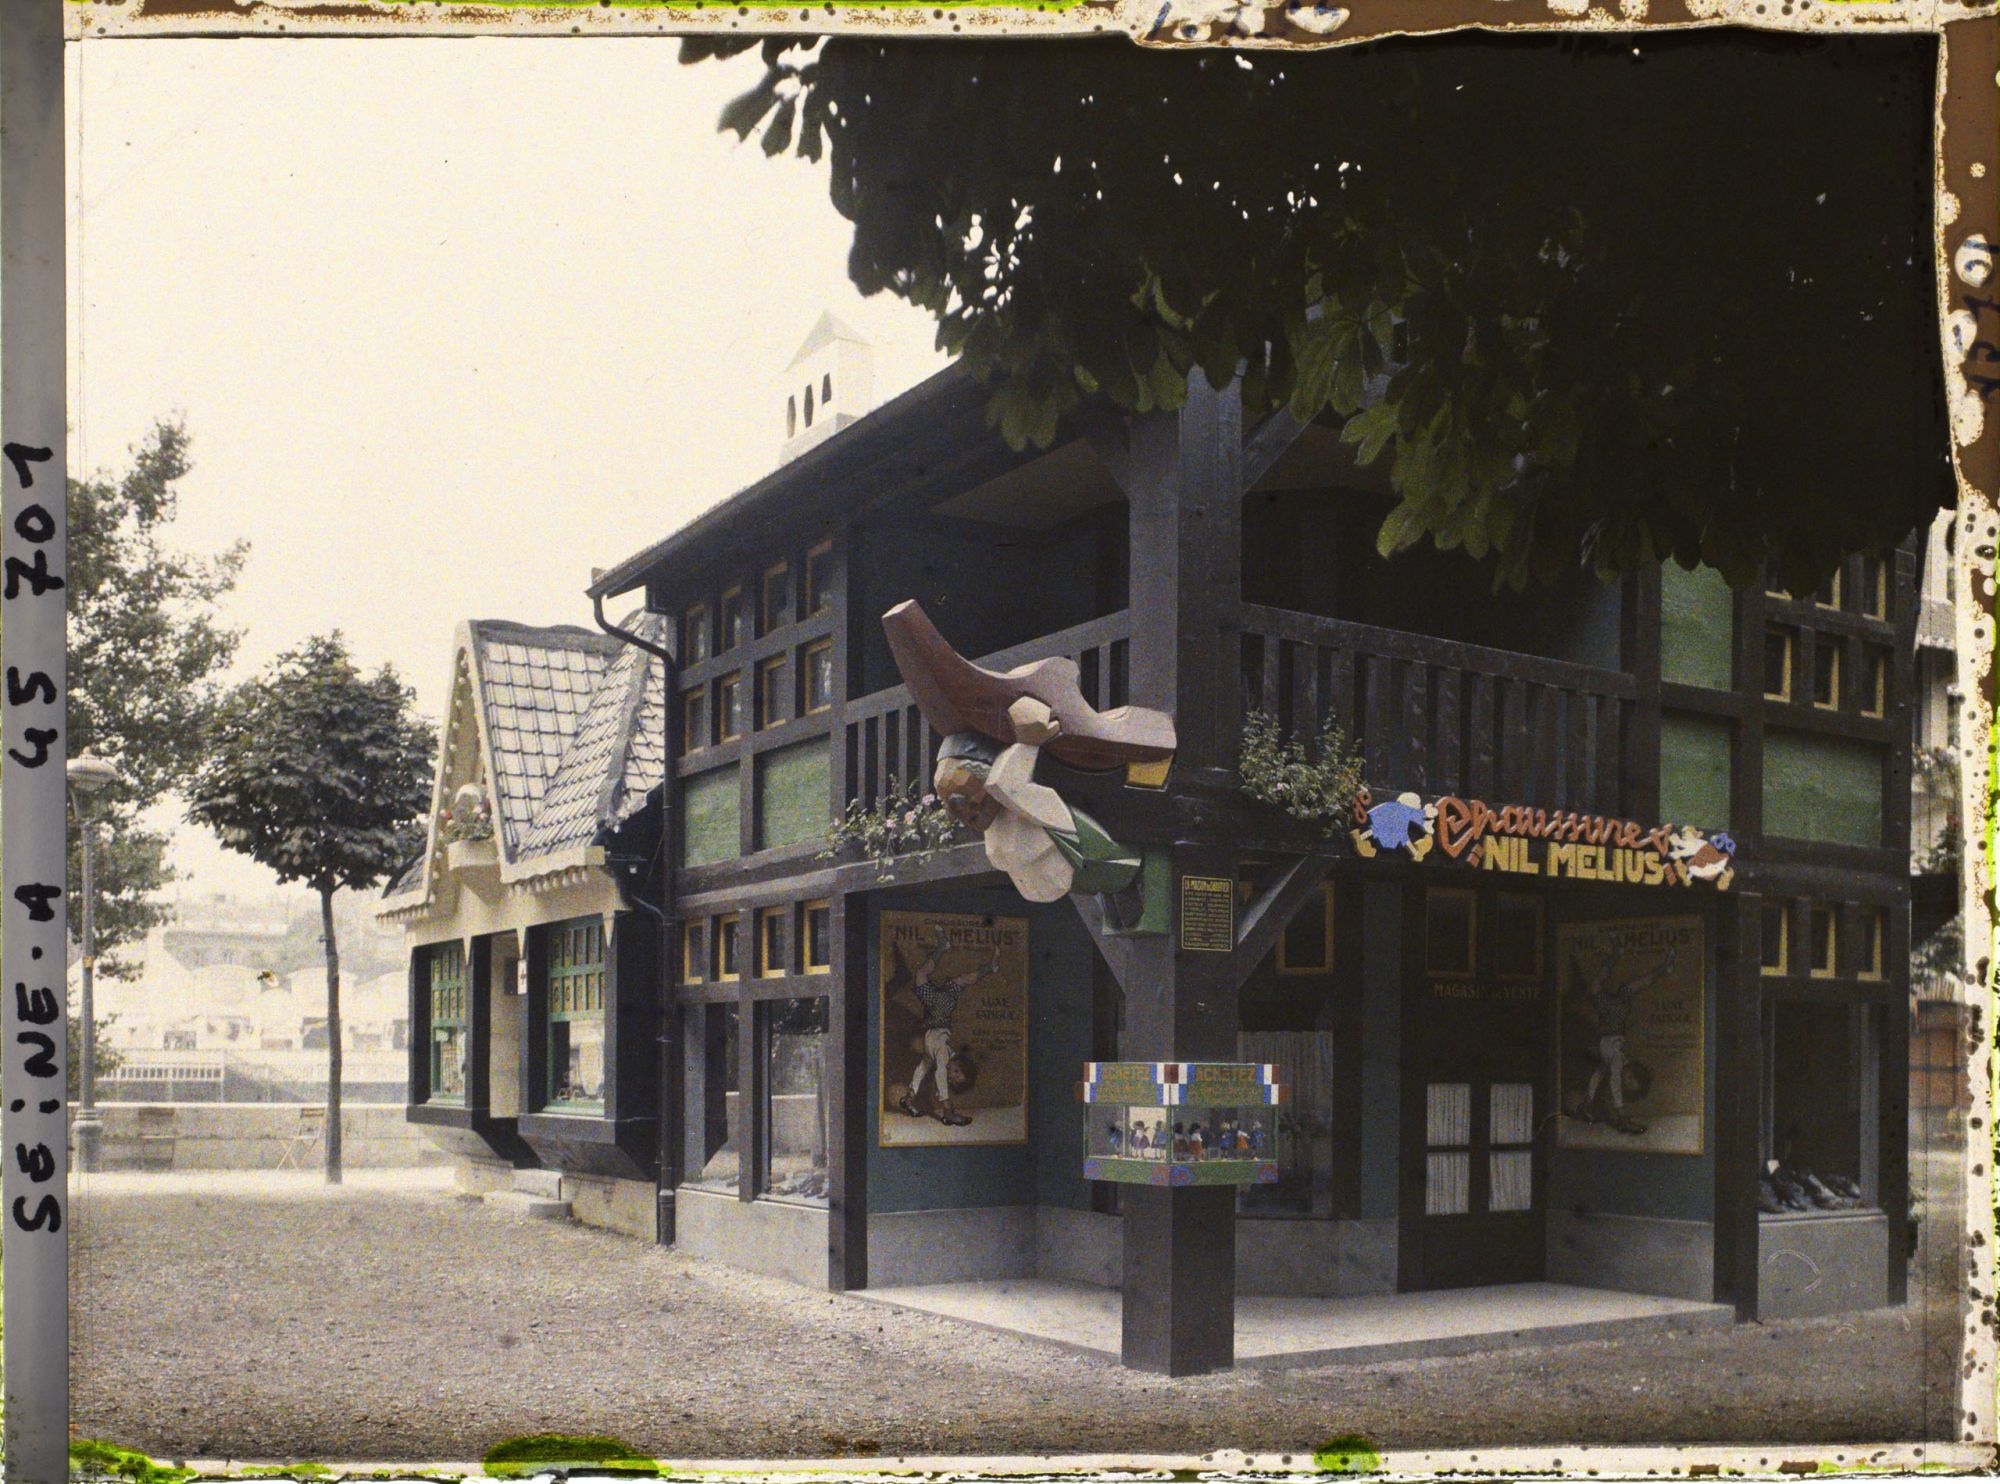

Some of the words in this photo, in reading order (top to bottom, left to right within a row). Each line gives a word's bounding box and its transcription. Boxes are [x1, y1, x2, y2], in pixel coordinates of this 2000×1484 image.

[1435, 796, 1673, 858] Chaussures
[1483, 835, 1539, 874] NIL
[1547, 841, 1664, 885] MELIUS
